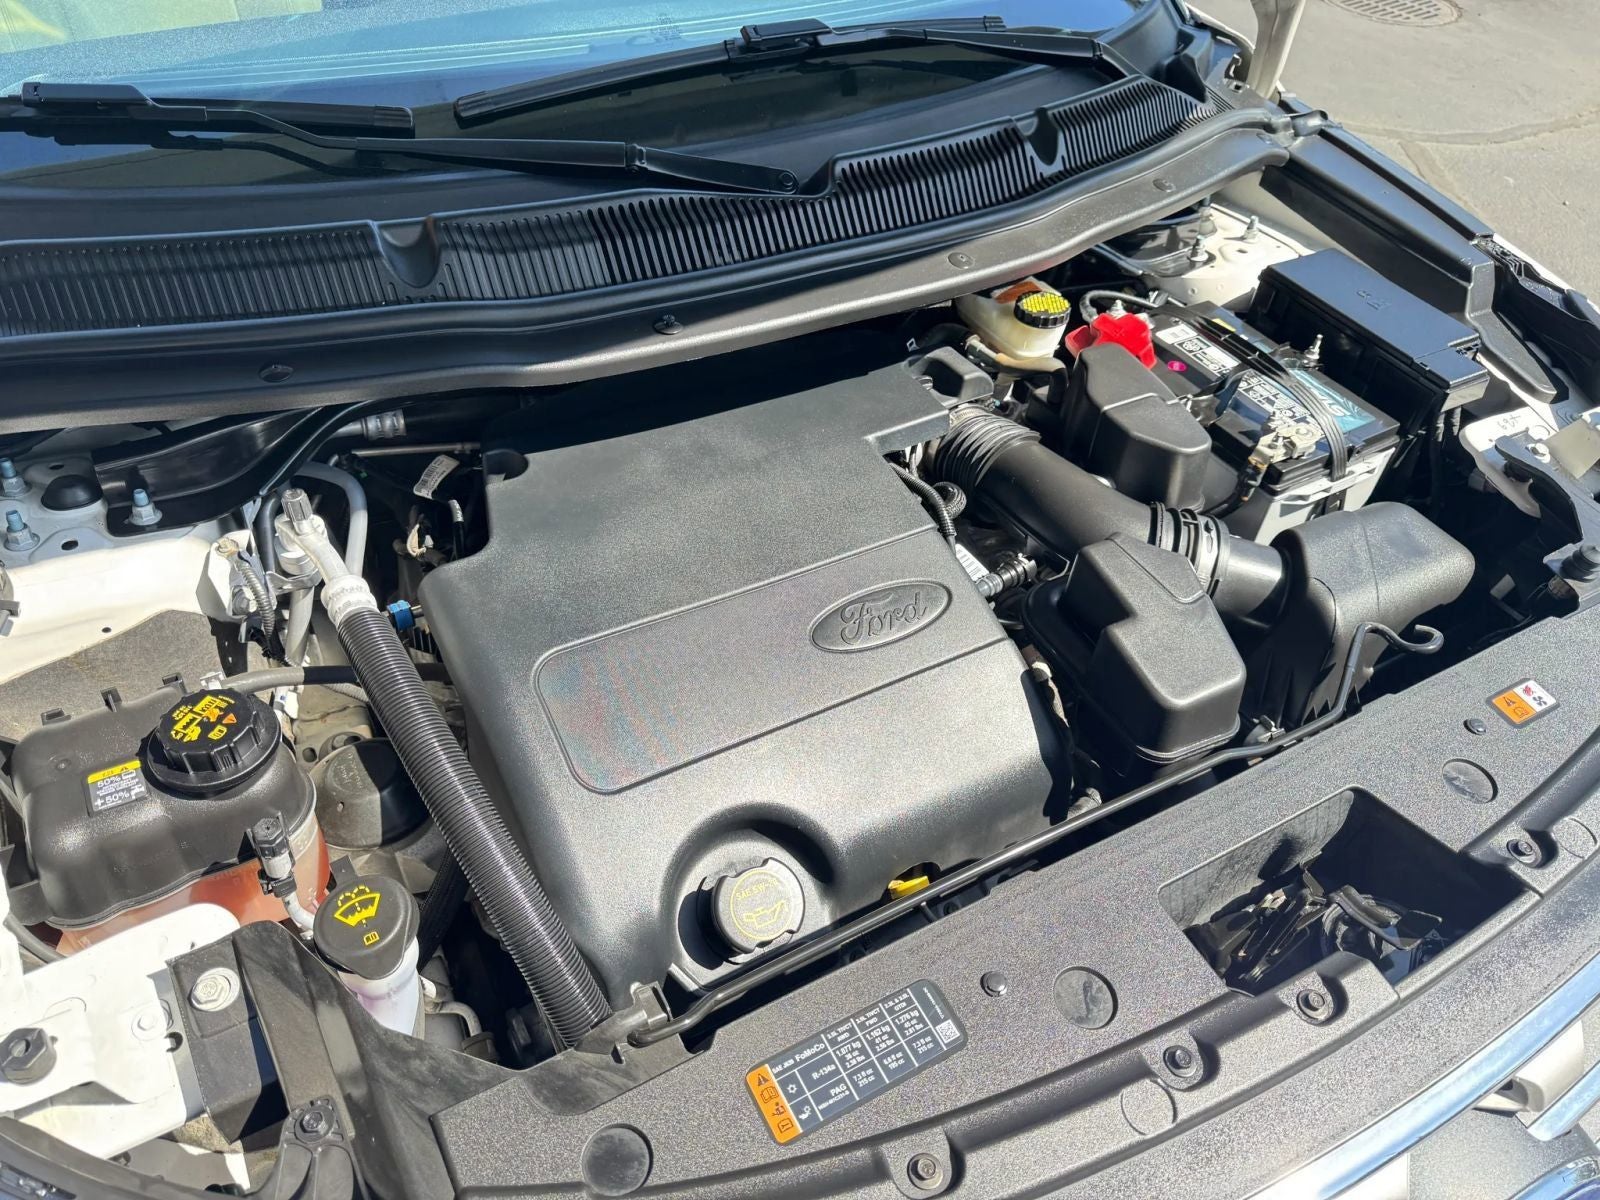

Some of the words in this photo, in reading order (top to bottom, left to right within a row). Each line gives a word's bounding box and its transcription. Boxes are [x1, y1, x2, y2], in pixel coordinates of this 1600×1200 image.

[840, 592, 927, 645] Ford
[736, 888, 752, 901] SAE
[909, 1009, 920, 1017] kg
[837, 1032, 850, 1042] AWD
[865, 1028, 882, 1041] 1.162
[880, 1024, 891, 1033] kg
[851, 1040, 862, 1049] kg
[917, 1045, 928, 1054] 215
[794, 1042, 826, 1062] FoMoCo
[811, 1063, 837, 1080] R-134a
[857, 1077, 869, 1088] 215
[829, 1083, 848, 1097] PAG
